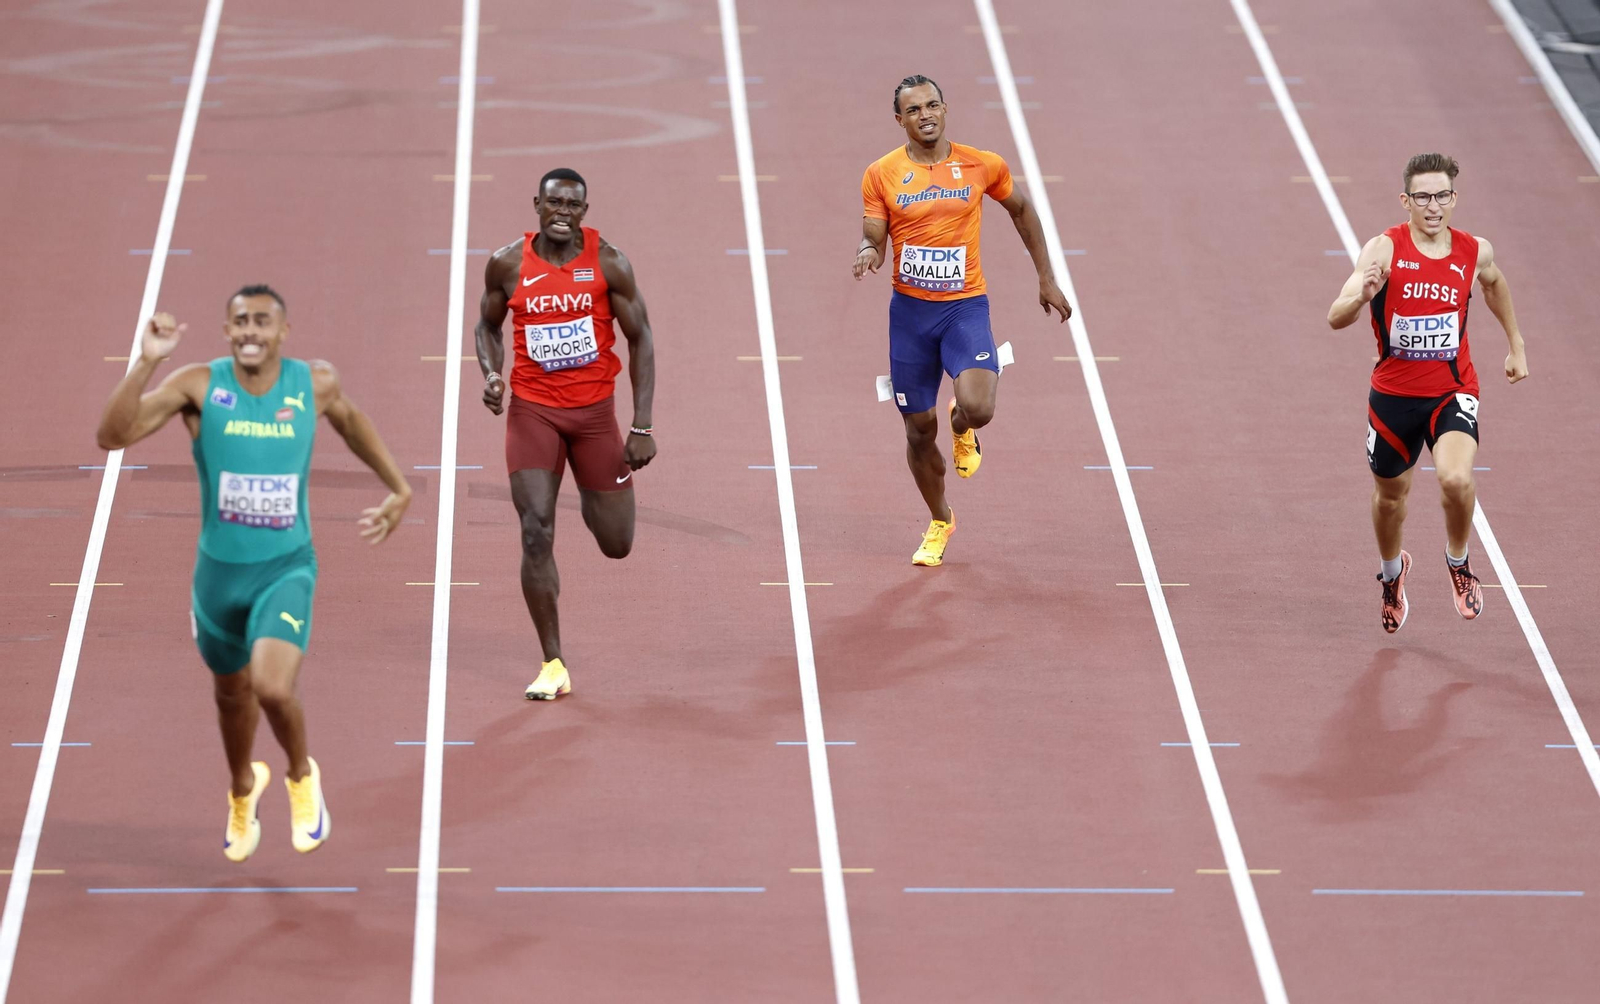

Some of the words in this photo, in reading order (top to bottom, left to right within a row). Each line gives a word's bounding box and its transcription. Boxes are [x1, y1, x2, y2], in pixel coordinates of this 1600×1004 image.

[917, 248, 960, 262] TDK
[902, 262, 962, 279] OMALLA
[1405, 262, 1420, 270] UBS
[525, 293, 593, 313] KENYA
[542, 320, 588, 340] TDK
[1409, 314, 1454, 331] TDK
[531, 336, 593, 359] KIPKORIR
[1399, 333, 1451, 348] SPITZ
[223, 419, 296, 439] AUSTRALIA
[243, 477, 292, 492] TDK
[223, 495, 293, 512] HOLDER
